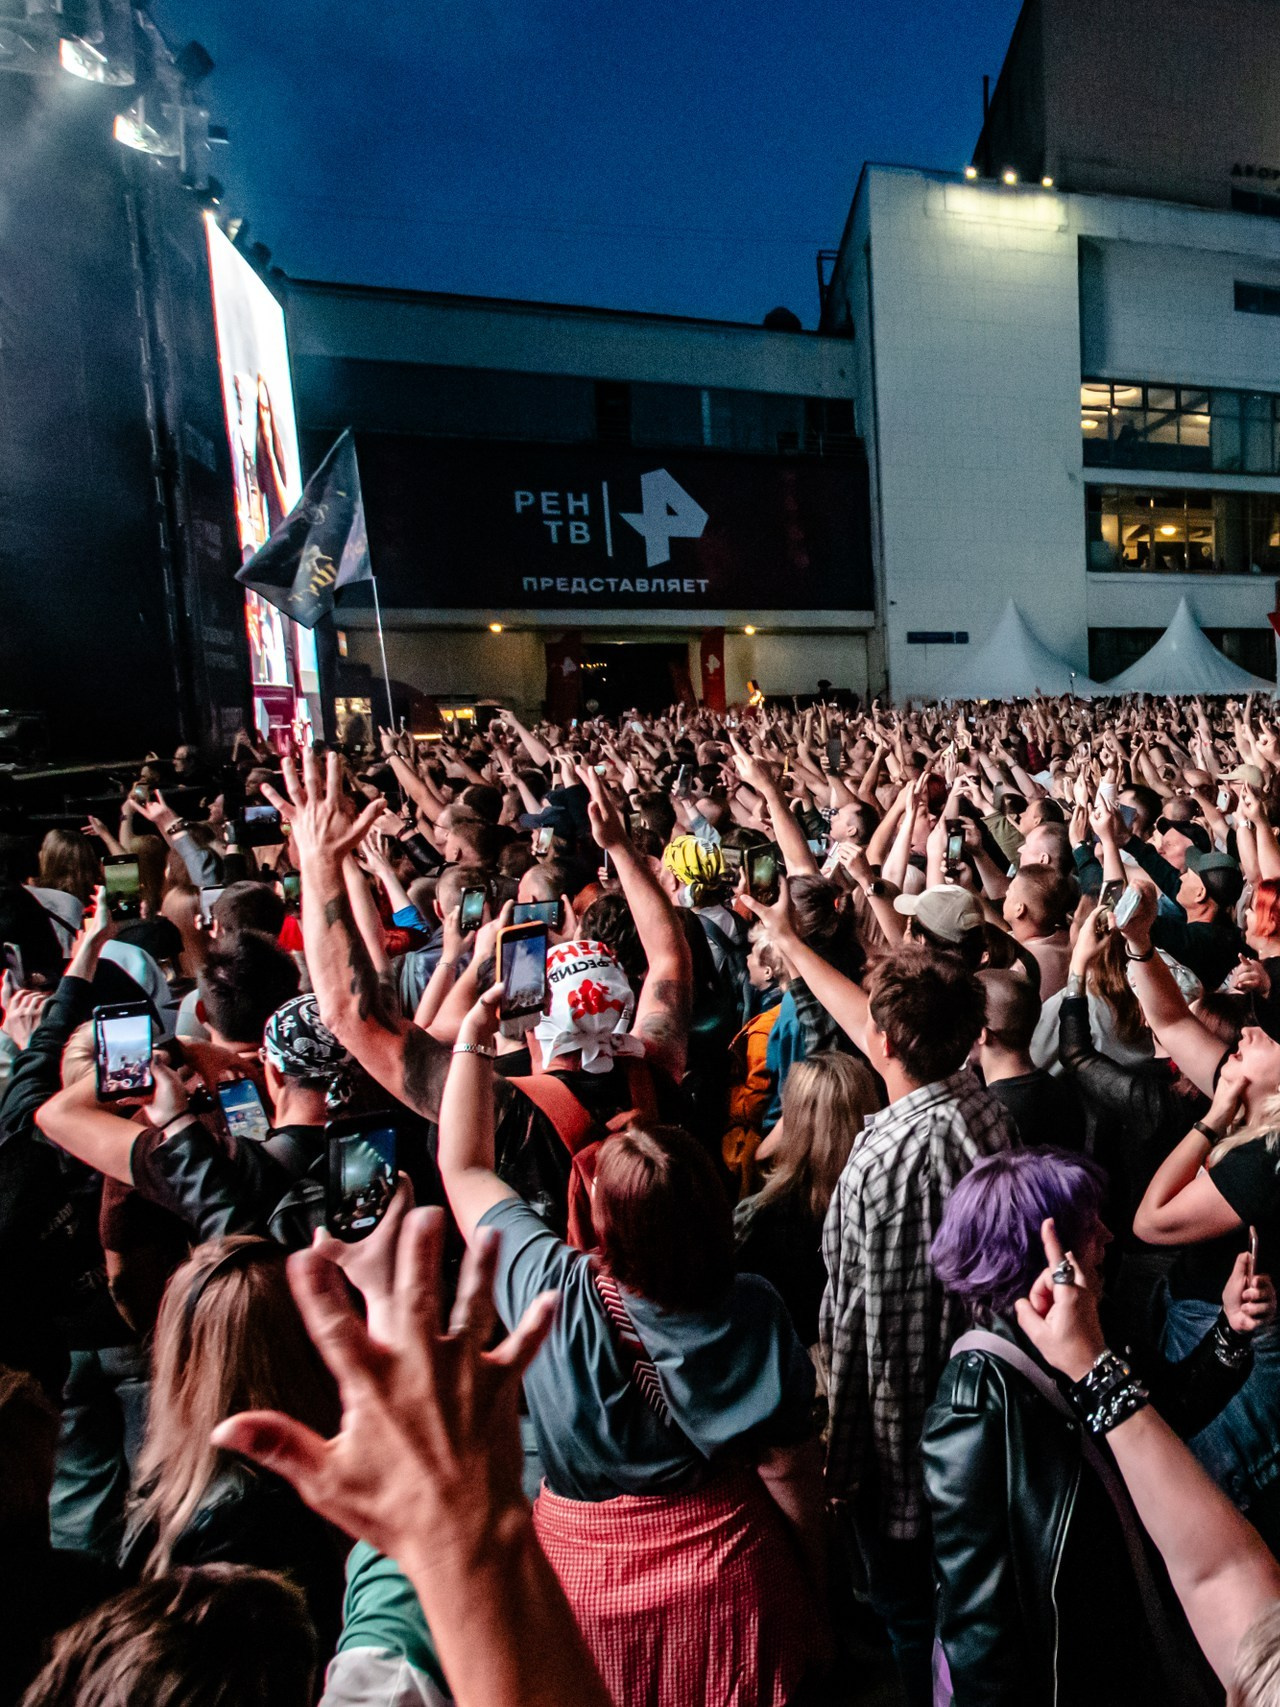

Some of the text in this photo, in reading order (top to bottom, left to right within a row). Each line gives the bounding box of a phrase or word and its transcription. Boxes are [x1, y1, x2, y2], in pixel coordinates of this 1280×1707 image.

[513, 489, 590, 517] РЕН
[542, 520, 591, 545] ТВ
[522, 576, 710, 595] ПРЕДСТАВЛЯЕТ
[549, 958, 611, 983] ФЕСТИВ
